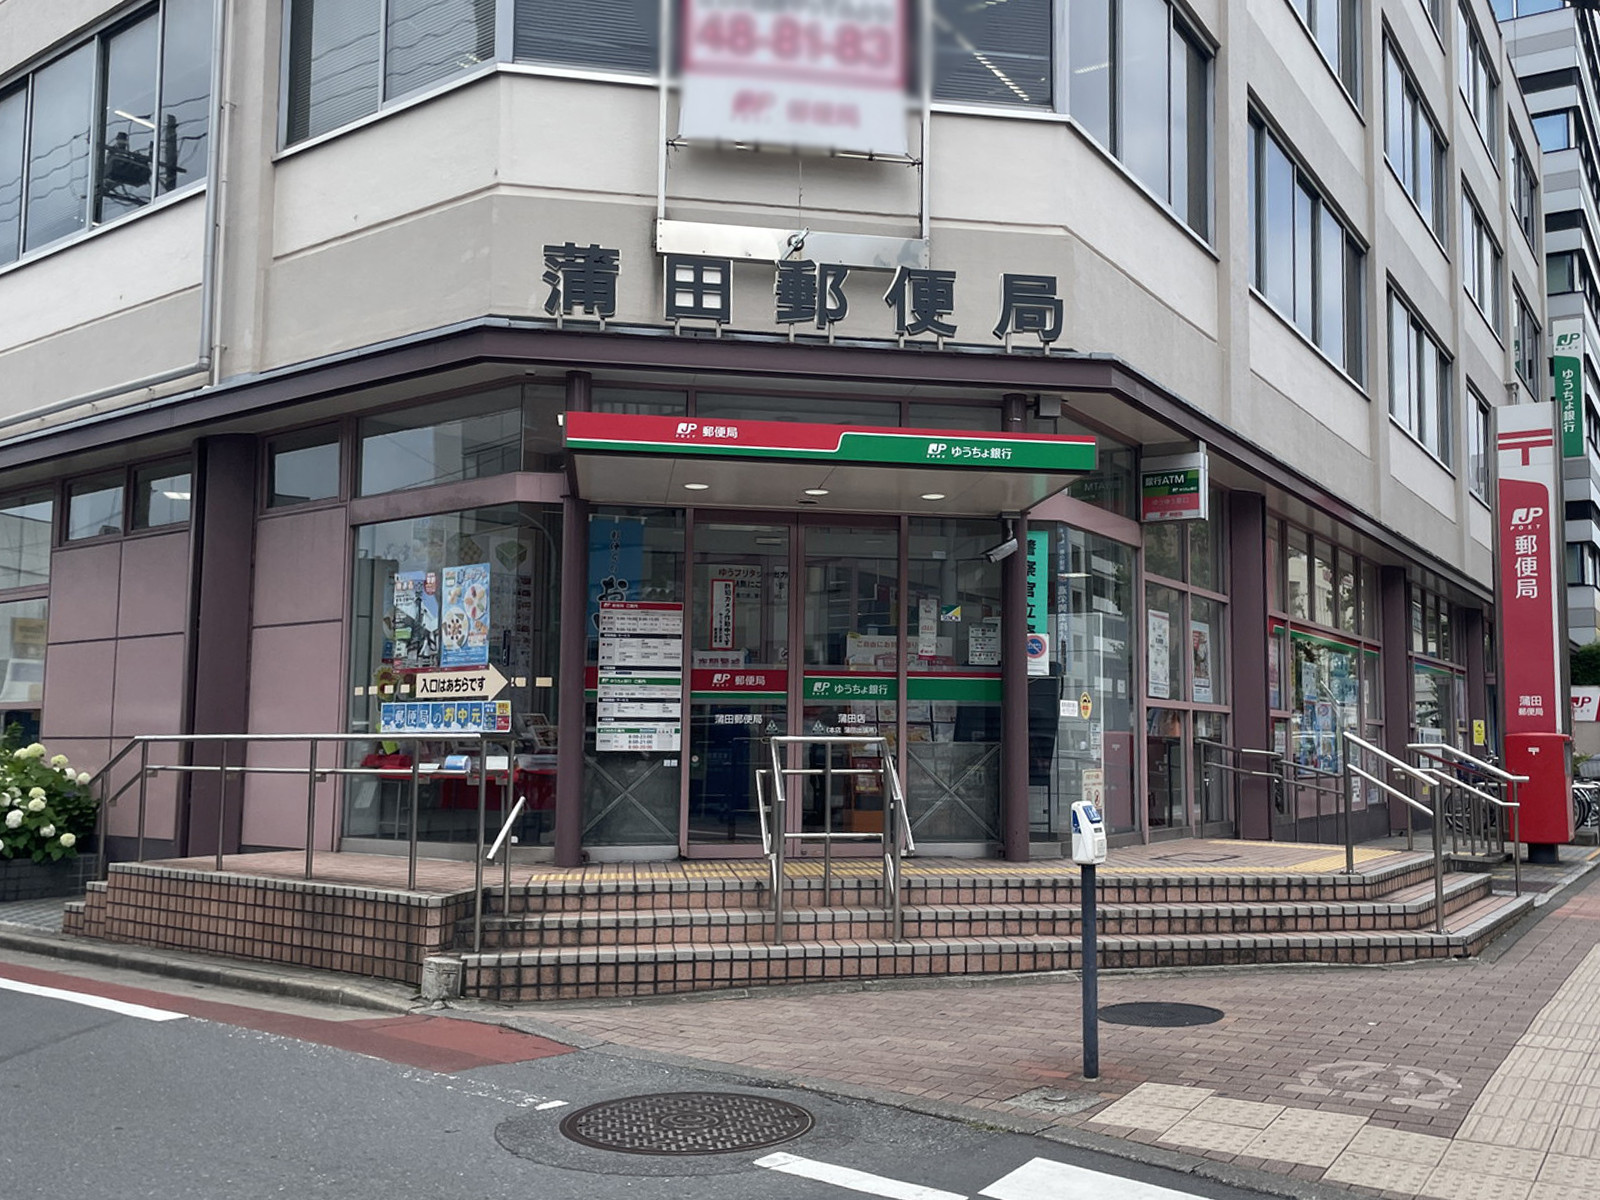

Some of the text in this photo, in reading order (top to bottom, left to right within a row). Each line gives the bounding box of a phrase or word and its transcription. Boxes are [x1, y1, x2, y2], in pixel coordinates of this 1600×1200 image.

[542, 241, 1064, 343] 蒲田郵便局
[1557, 333, 1580, 346] JP
[1562, 368, 1576, 433] ゆうちょ銀行
[702, 426, 738, 439] 郵便局
[951, 446, 1012, 460] ゆうちょ銀行
[1511, 507, 1543, 525] JP
[1514, 534, 1538, 600] 郵便局
[420, 676, 486, 693] 入口はあちらです
[735, 675, 766, 686] 郵便局
[834, 684, 888, 695] ゆうちょ銀行
[1519, 695, 1542, 707] 蒲田
[1518, 707, 1544, 716] 郵便局
[714, 714, 763, 725] 蒲田郵便局
[838, 713, 866, 724] 蒲田店
